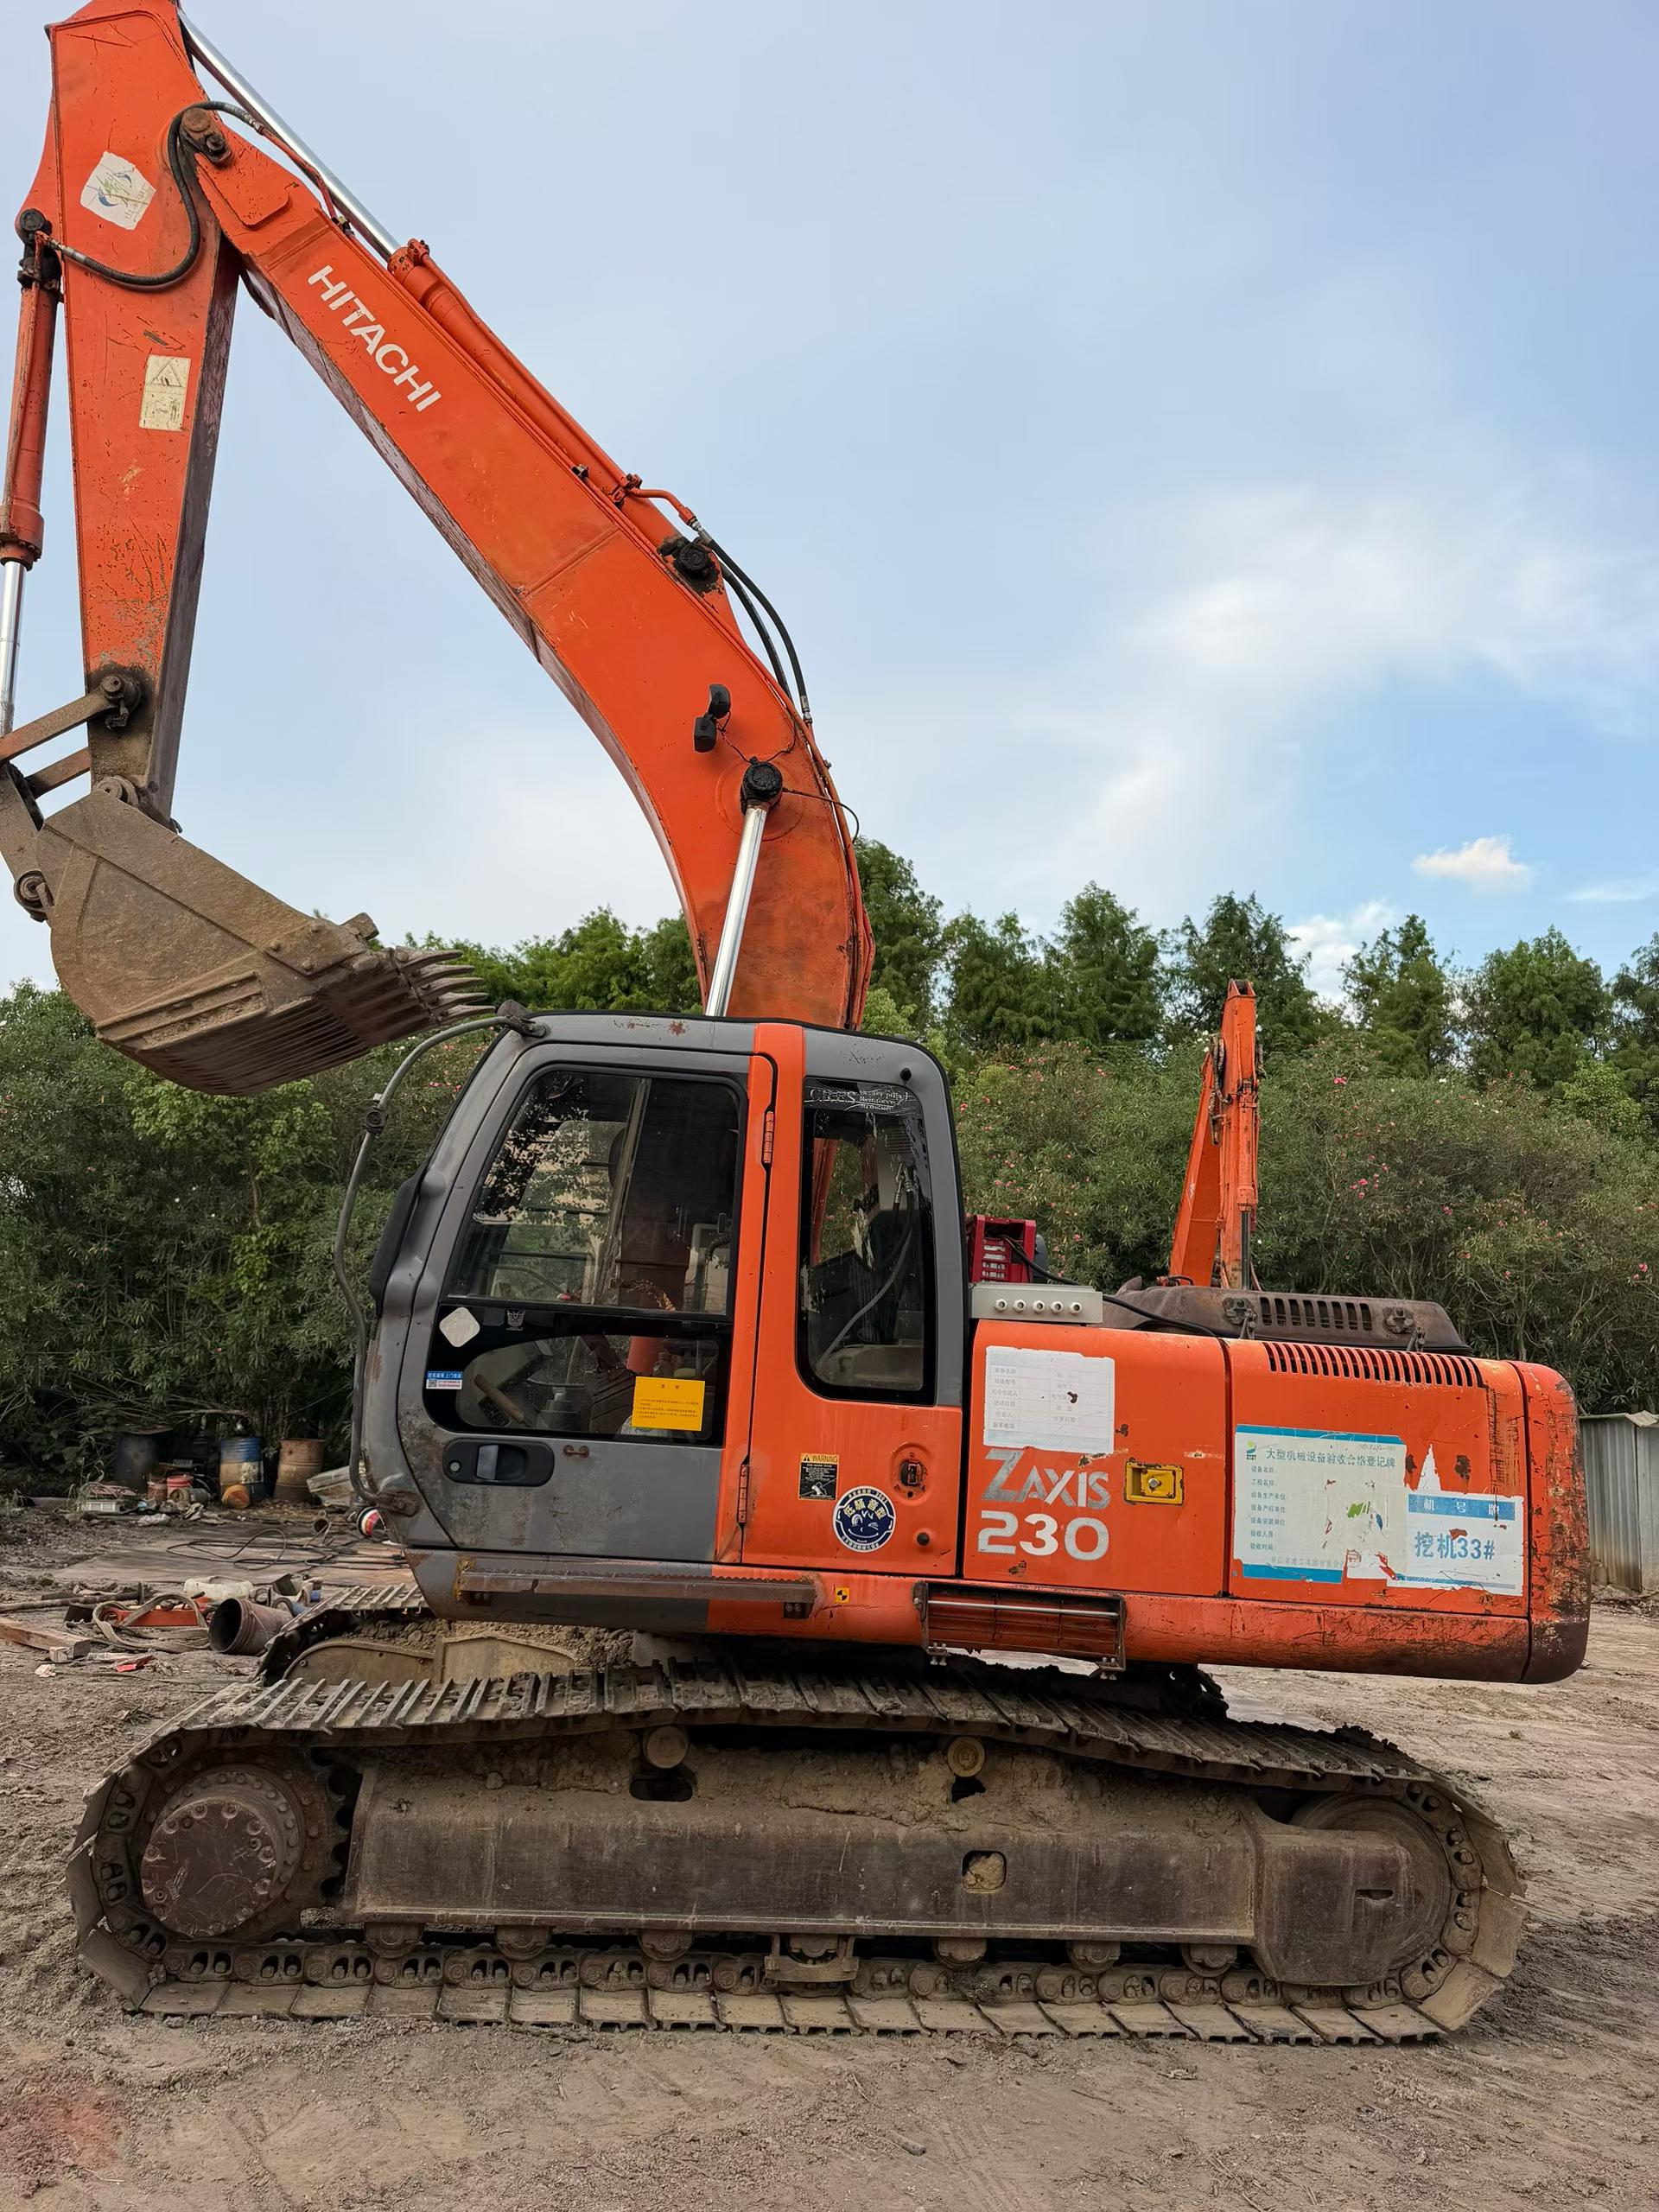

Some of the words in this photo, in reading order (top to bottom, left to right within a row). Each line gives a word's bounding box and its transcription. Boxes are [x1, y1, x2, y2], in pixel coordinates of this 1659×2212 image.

[308, 264, 442, 412] HITACHI
[812, 1454, 838, 1463] WARNING
[1266, 1447, 1396, 1469] 大型机械设备验收合格登记牌
[981, 1448, 1111, 1510] ZAXIS
[977, 1510, 1110, 1561] 230
[1414, 1531, 1495, 1560] 挖机33#
